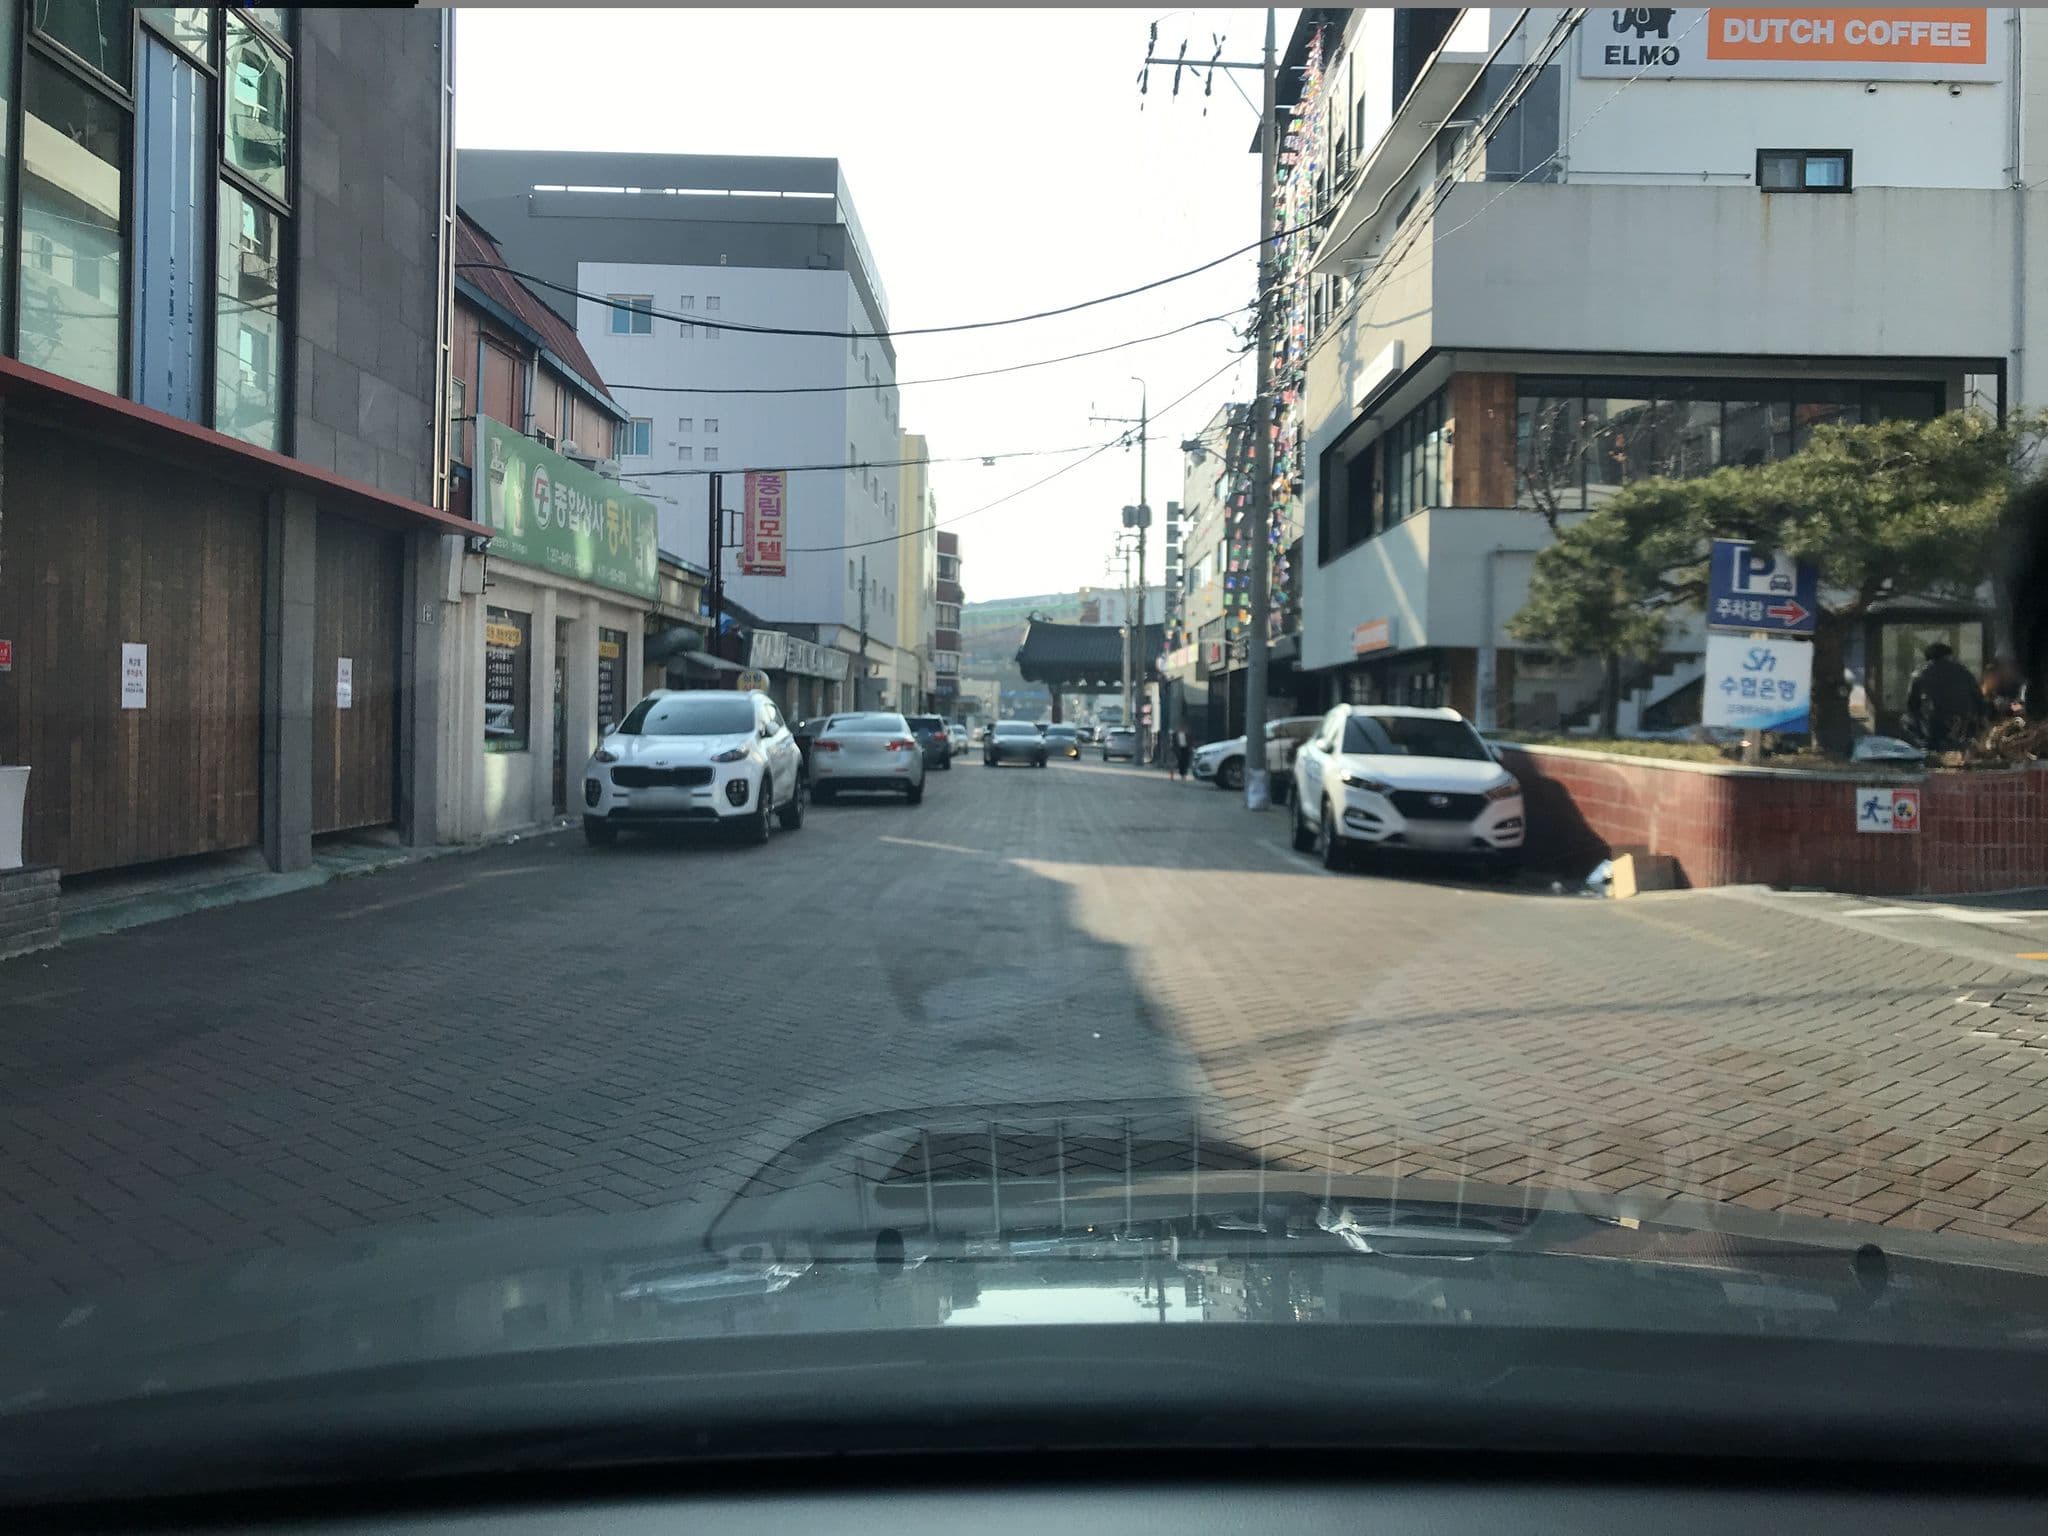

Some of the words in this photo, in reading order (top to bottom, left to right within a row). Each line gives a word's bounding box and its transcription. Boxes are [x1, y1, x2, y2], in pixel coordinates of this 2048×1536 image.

[1723, 18, 1835, 44] DUTCH
[1844, 19, 1971, 47] COFFEE
[1605, 45, 1680, 66] ELMO
[555, 481, 605, 541] 종합상사
[606, 499, 633, 559] 동서
[757, 474, 783, 562] 풍림모텔
[1738, 549, 1776, 590] P
[1717, 598, 1763, 621] 주차장
[1743, 647, 1776, 672] Sh
[1719, 675, 1798, 703] 수협은행
